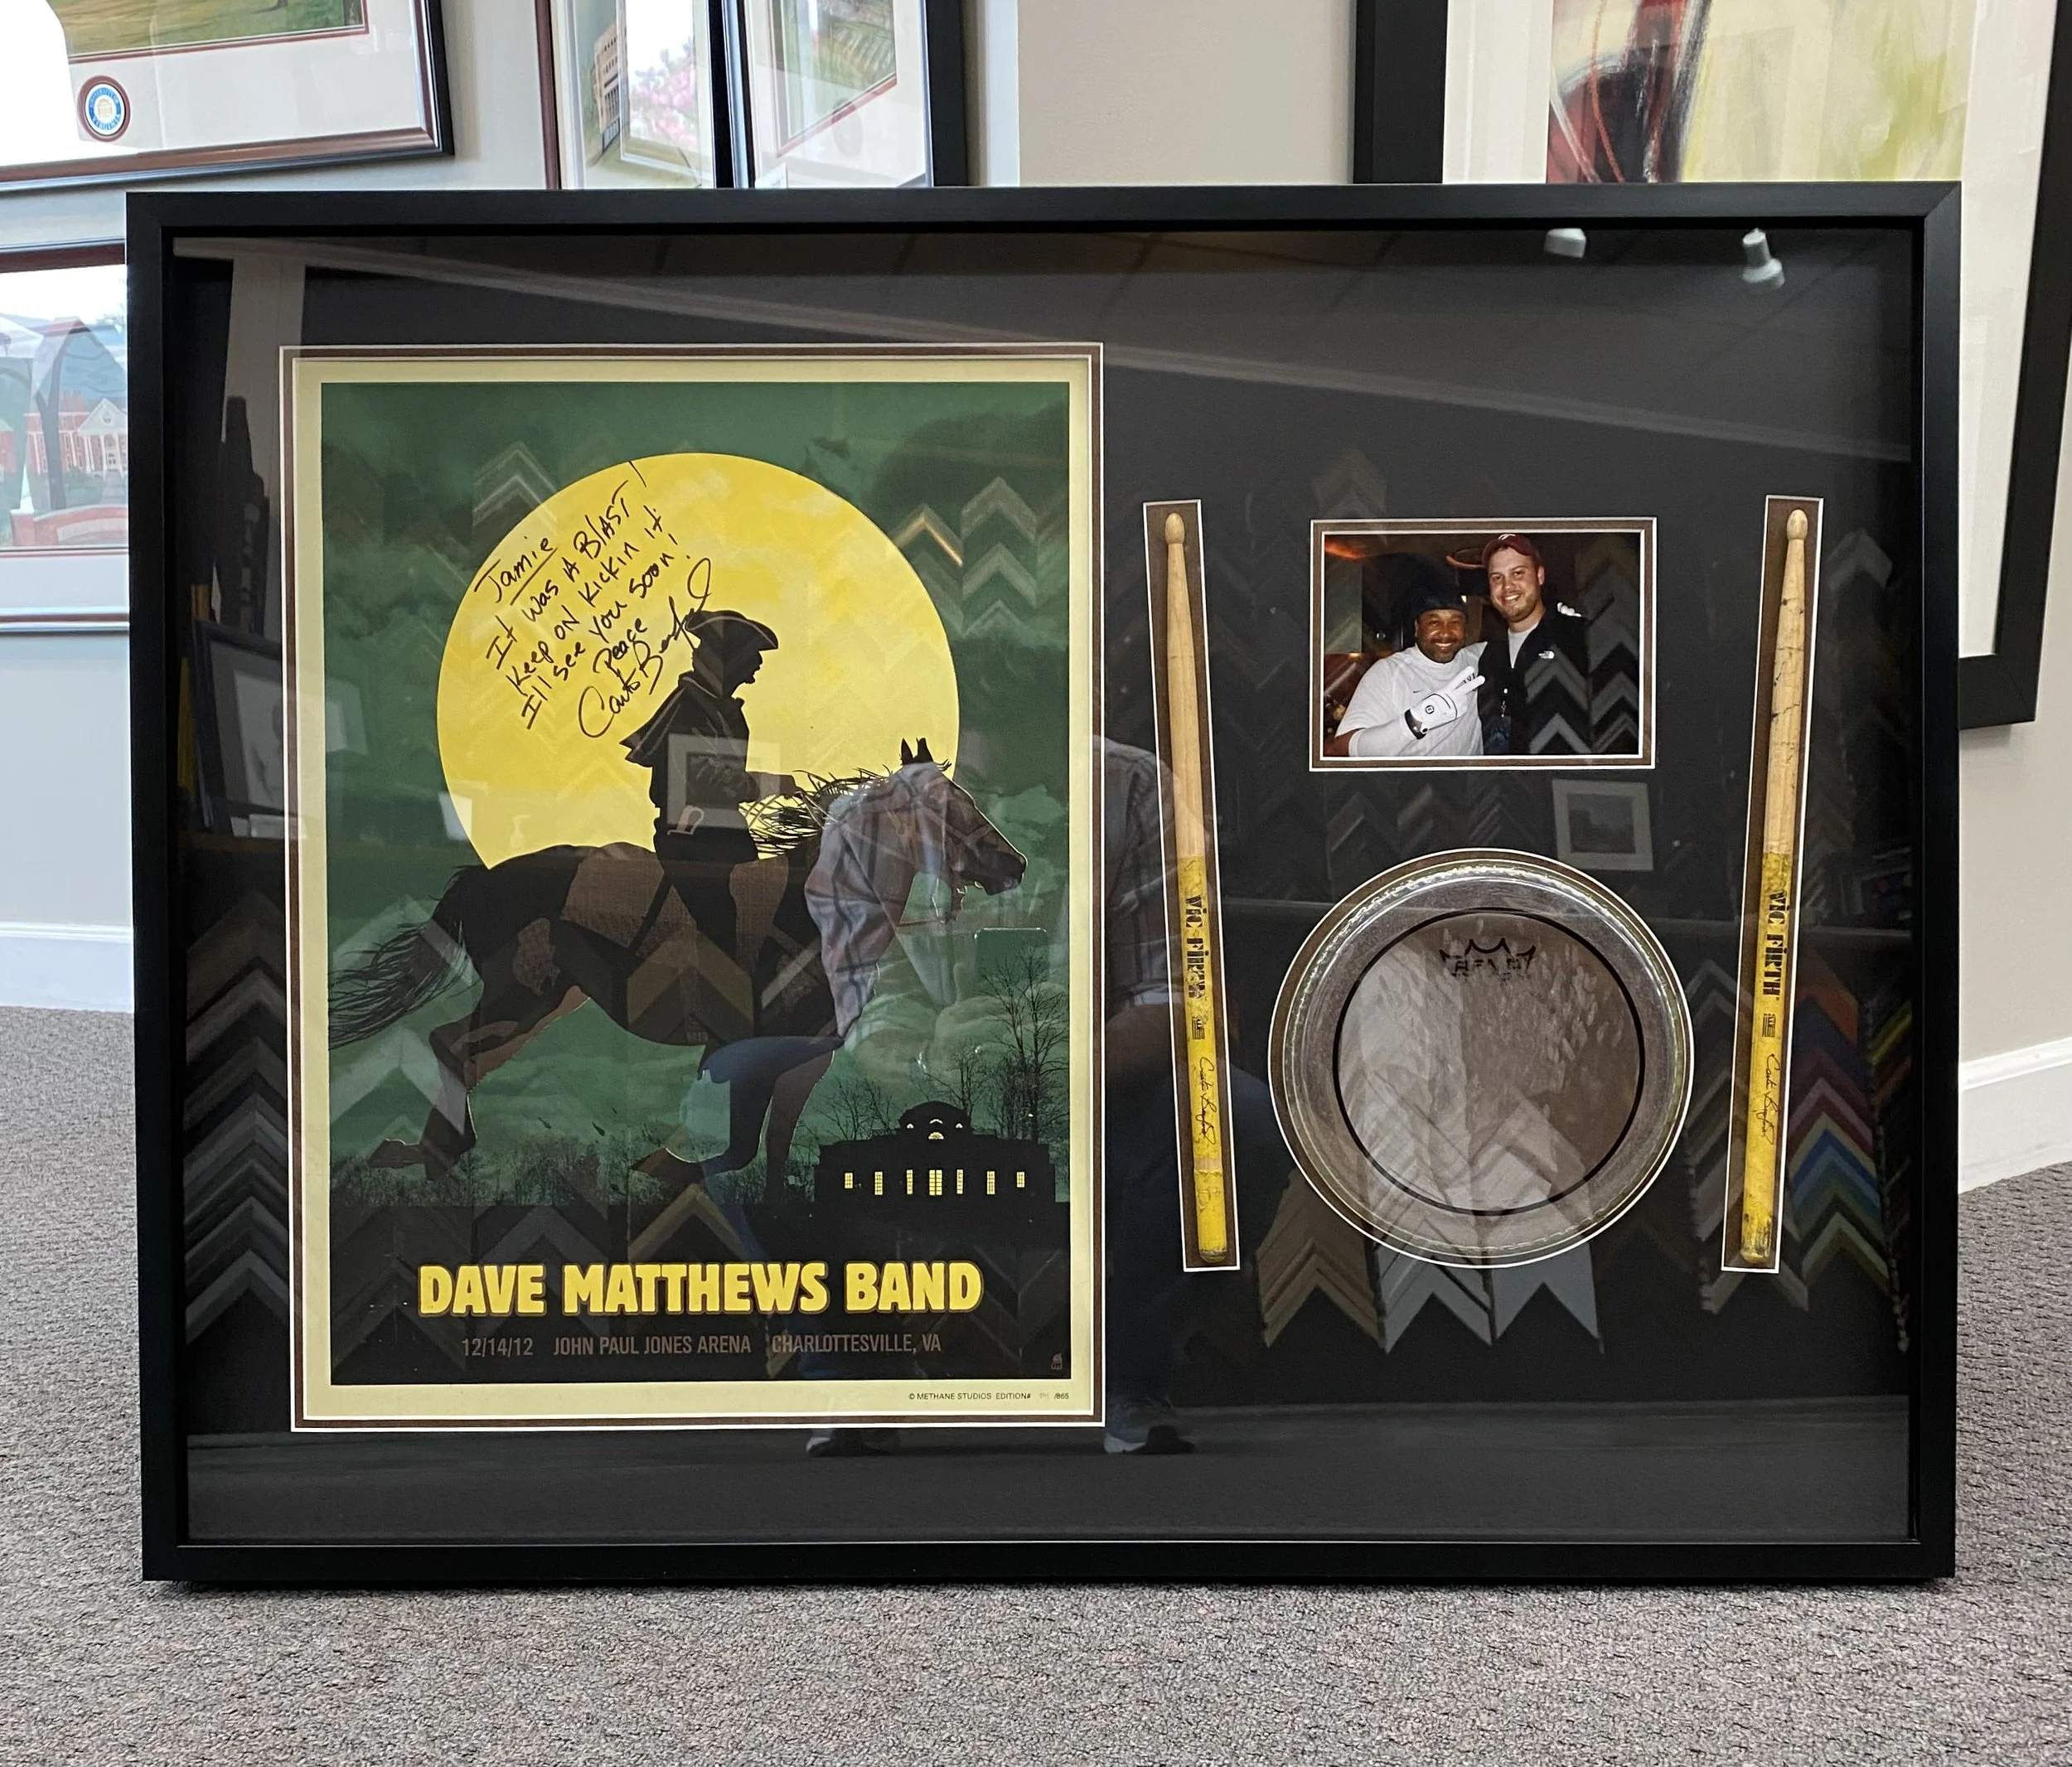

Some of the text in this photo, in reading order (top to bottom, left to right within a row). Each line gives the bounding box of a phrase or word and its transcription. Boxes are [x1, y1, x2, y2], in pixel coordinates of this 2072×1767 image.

[473, 536, 554, 603] Jamie
[486, 615, 519, 670] It
[562, 556, 580, 583] A
[506, 640, 550, 697] Keep
[418, 1261, 983, 1316] DAVE MATTHEWS BAND
[461, 1334, 942, 1358] 12/14/12 JOHN PAUL JONES ARENA CHARLOTTESVILLE, VA
